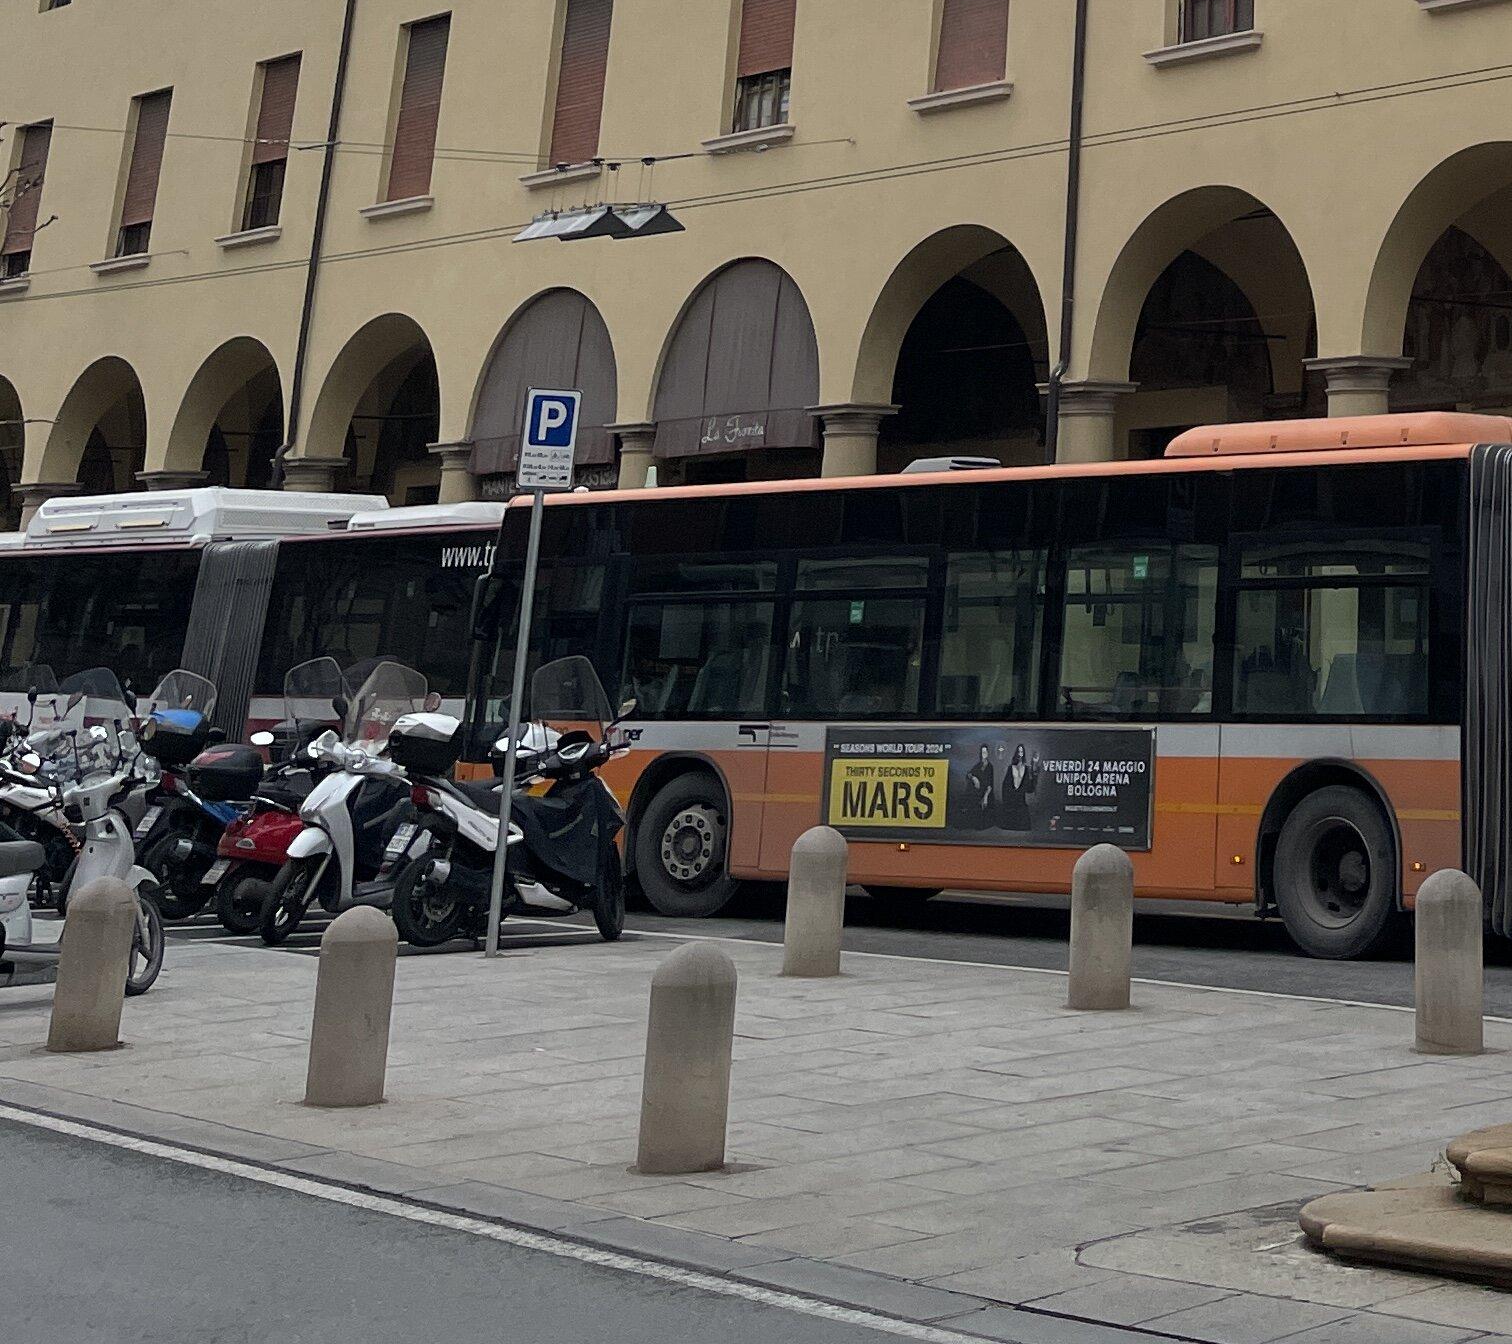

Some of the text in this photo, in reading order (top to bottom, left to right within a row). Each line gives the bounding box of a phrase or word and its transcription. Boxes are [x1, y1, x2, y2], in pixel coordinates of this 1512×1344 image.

[537, 399, 568, 441] P
[876, 743, 903, 754] WORLD
[904, 743, 925, 754] TOUR
[925, 743, 944, 754] 2024
[846, 765, 936, 778] THIRTY SECONDS TO
[1087, 760, 1101, 773] 24
[1102, 760, 1146, 773] MAGGIO
[1055, 772, 1130, 785] UNIPOL ARENA
[1067, 784, 1118, 797] BOLOGNA
[841, 780, 935, 820] MARS
